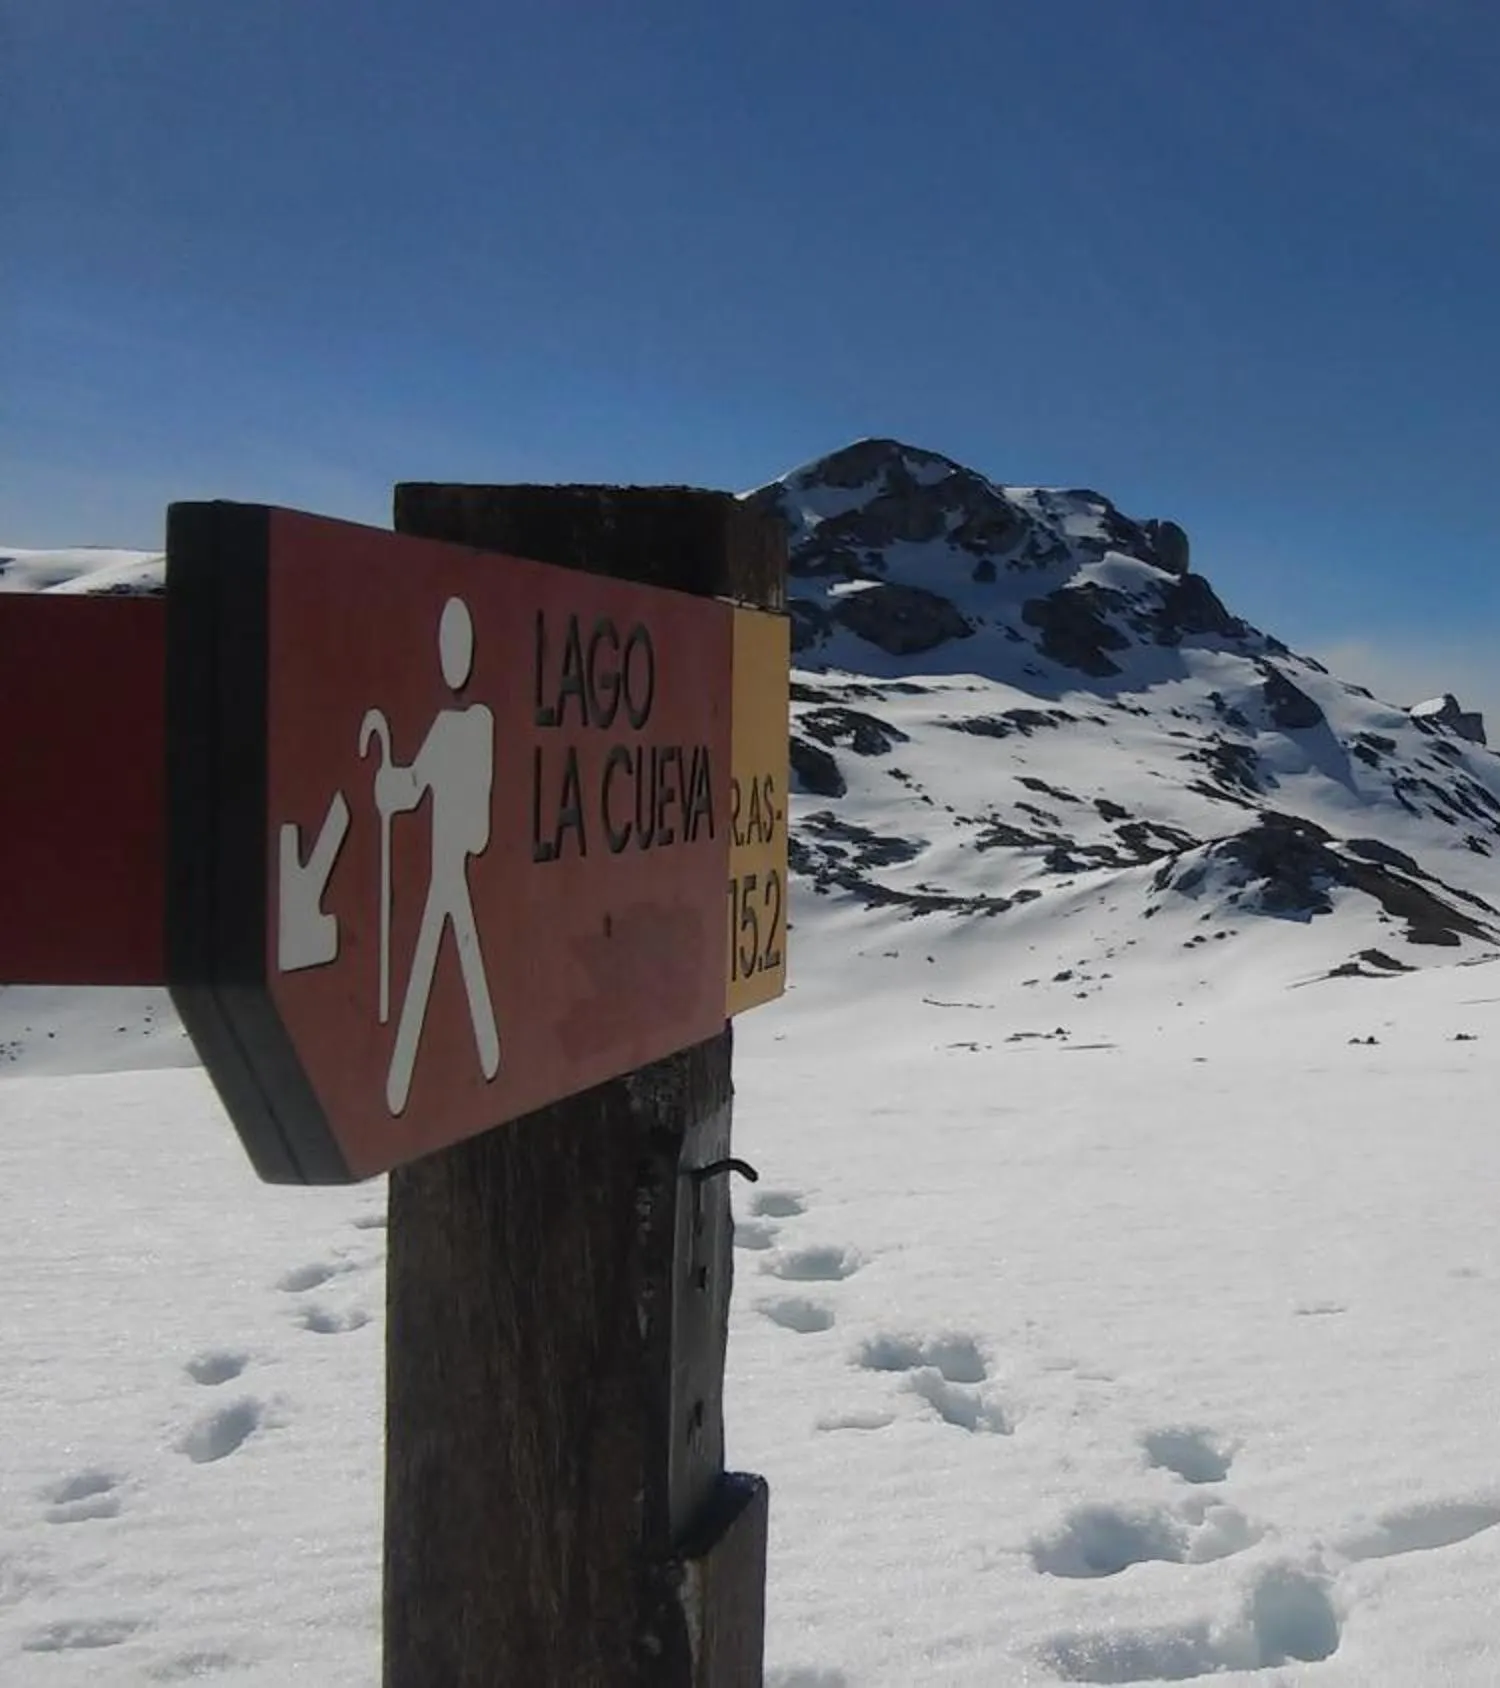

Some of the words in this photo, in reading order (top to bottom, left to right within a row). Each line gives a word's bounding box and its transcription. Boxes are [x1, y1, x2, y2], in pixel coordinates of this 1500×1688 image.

[535, 609, 655, 730] LAGO
[533, 745, 587, 863] LA
[601, 744, 715, 854] CUEVA
